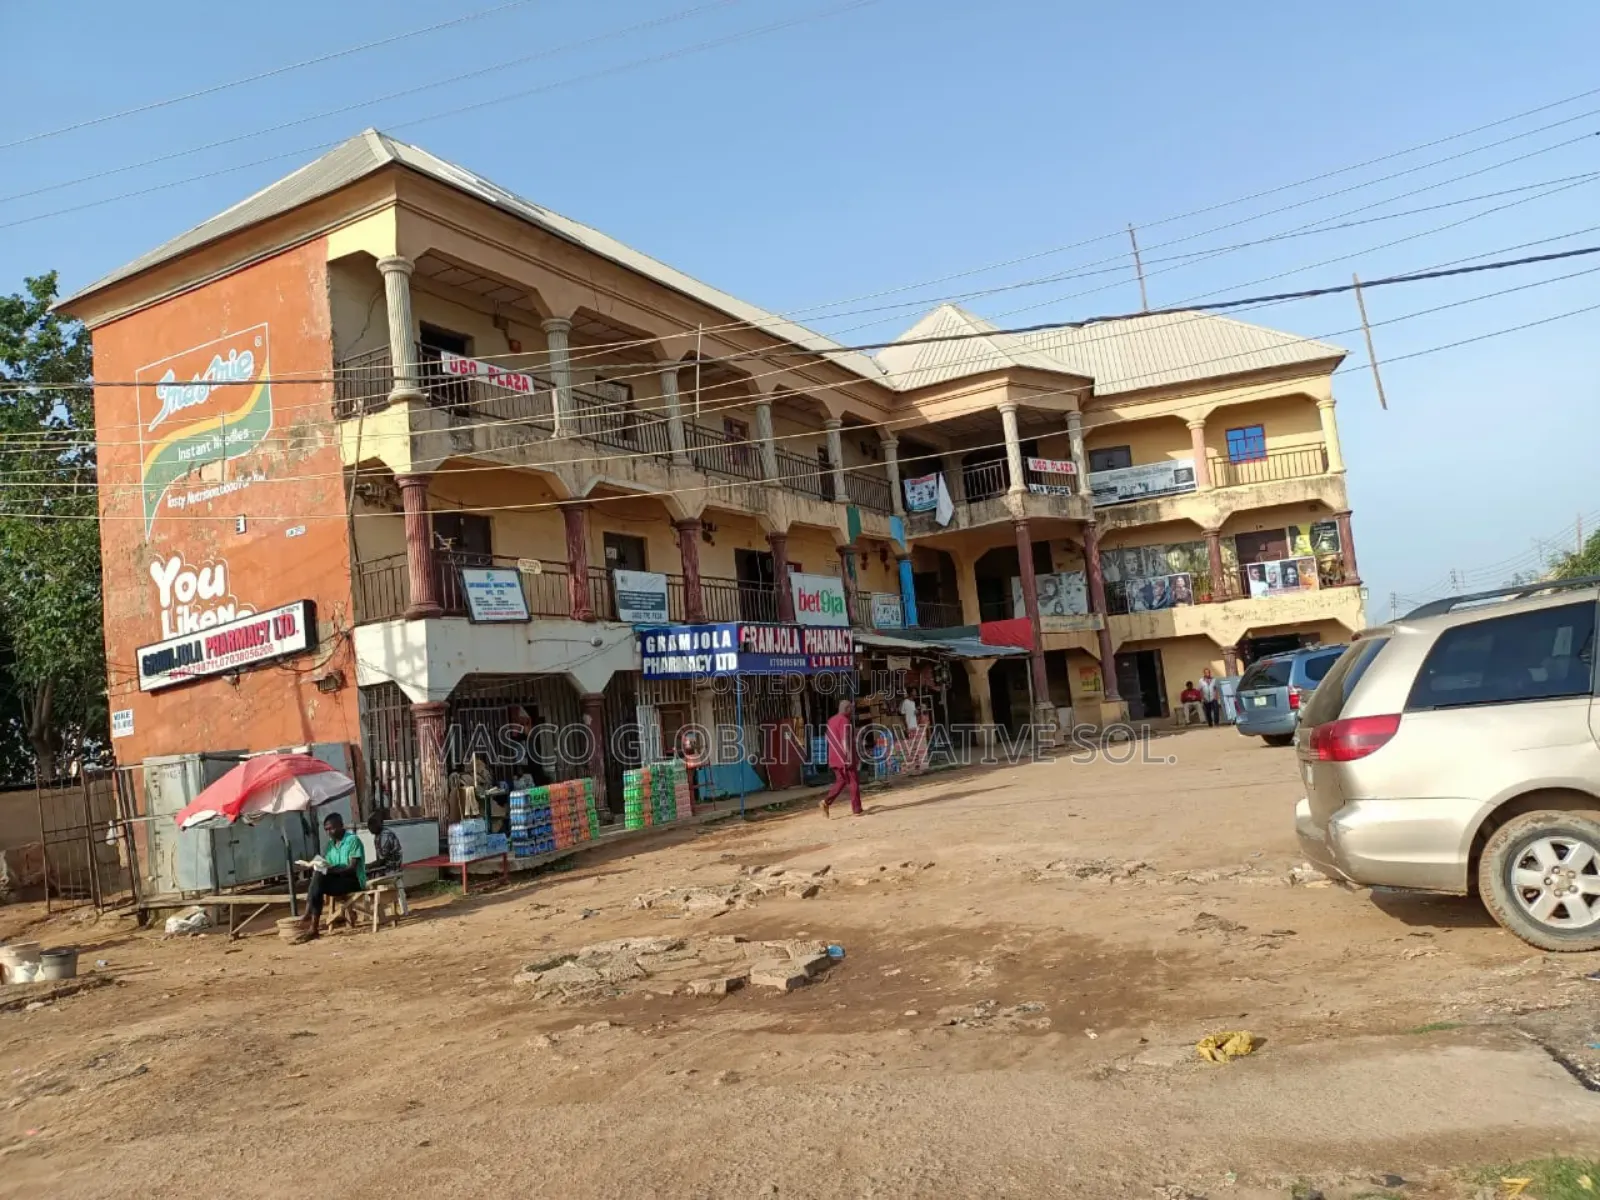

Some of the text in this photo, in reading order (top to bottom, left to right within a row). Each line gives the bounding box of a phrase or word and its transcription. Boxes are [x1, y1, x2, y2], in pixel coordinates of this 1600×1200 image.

[450, 356, 529, 391] UGO PLAZA
[178, 441, 211, 461] Instant
[150, 556, 225, 608] You
[798, 586, 843, 618] bet9ja
[205, 620, 271, 659] PHARMACY
[273, 613, 300, 641] LTD.
[646, 630, 731, 653] GRAMJOLA
[742, 626, 853, 653] GRAMJOLA PHARMACY
[644, 652, 738, 675] PHARMACY LTD
